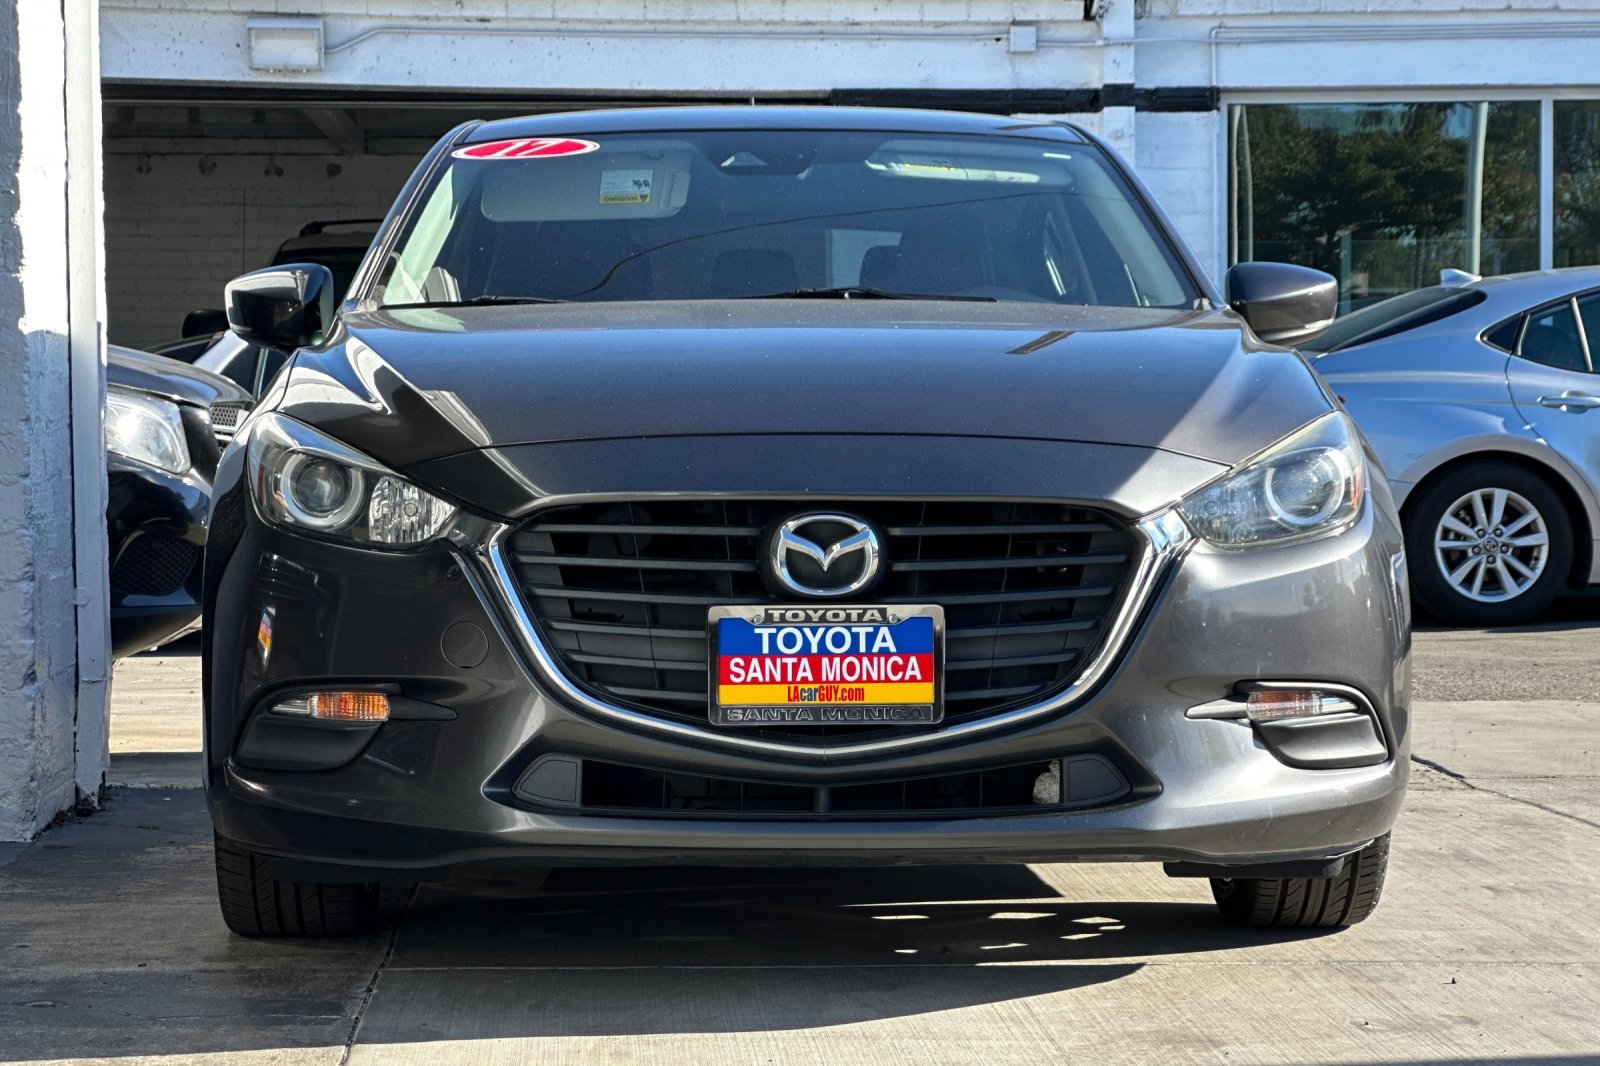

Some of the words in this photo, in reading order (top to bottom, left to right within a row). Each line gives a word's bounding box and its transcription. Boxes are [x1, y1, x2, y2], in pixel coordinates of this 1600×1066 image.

[488, 140, 566, 156] 17
[768, 609, 883, 622] TOYOTA
[754, 627, 897, 654] TOYOTA
[729, 657, 813, 683] SANTA
[822, 656, 922, 682] MONICA
[787, 685, 864, 702] LAcarGUY.com
[727, 708, 813, 721] SANTA
[821, 708, 925, 720] MONICA
